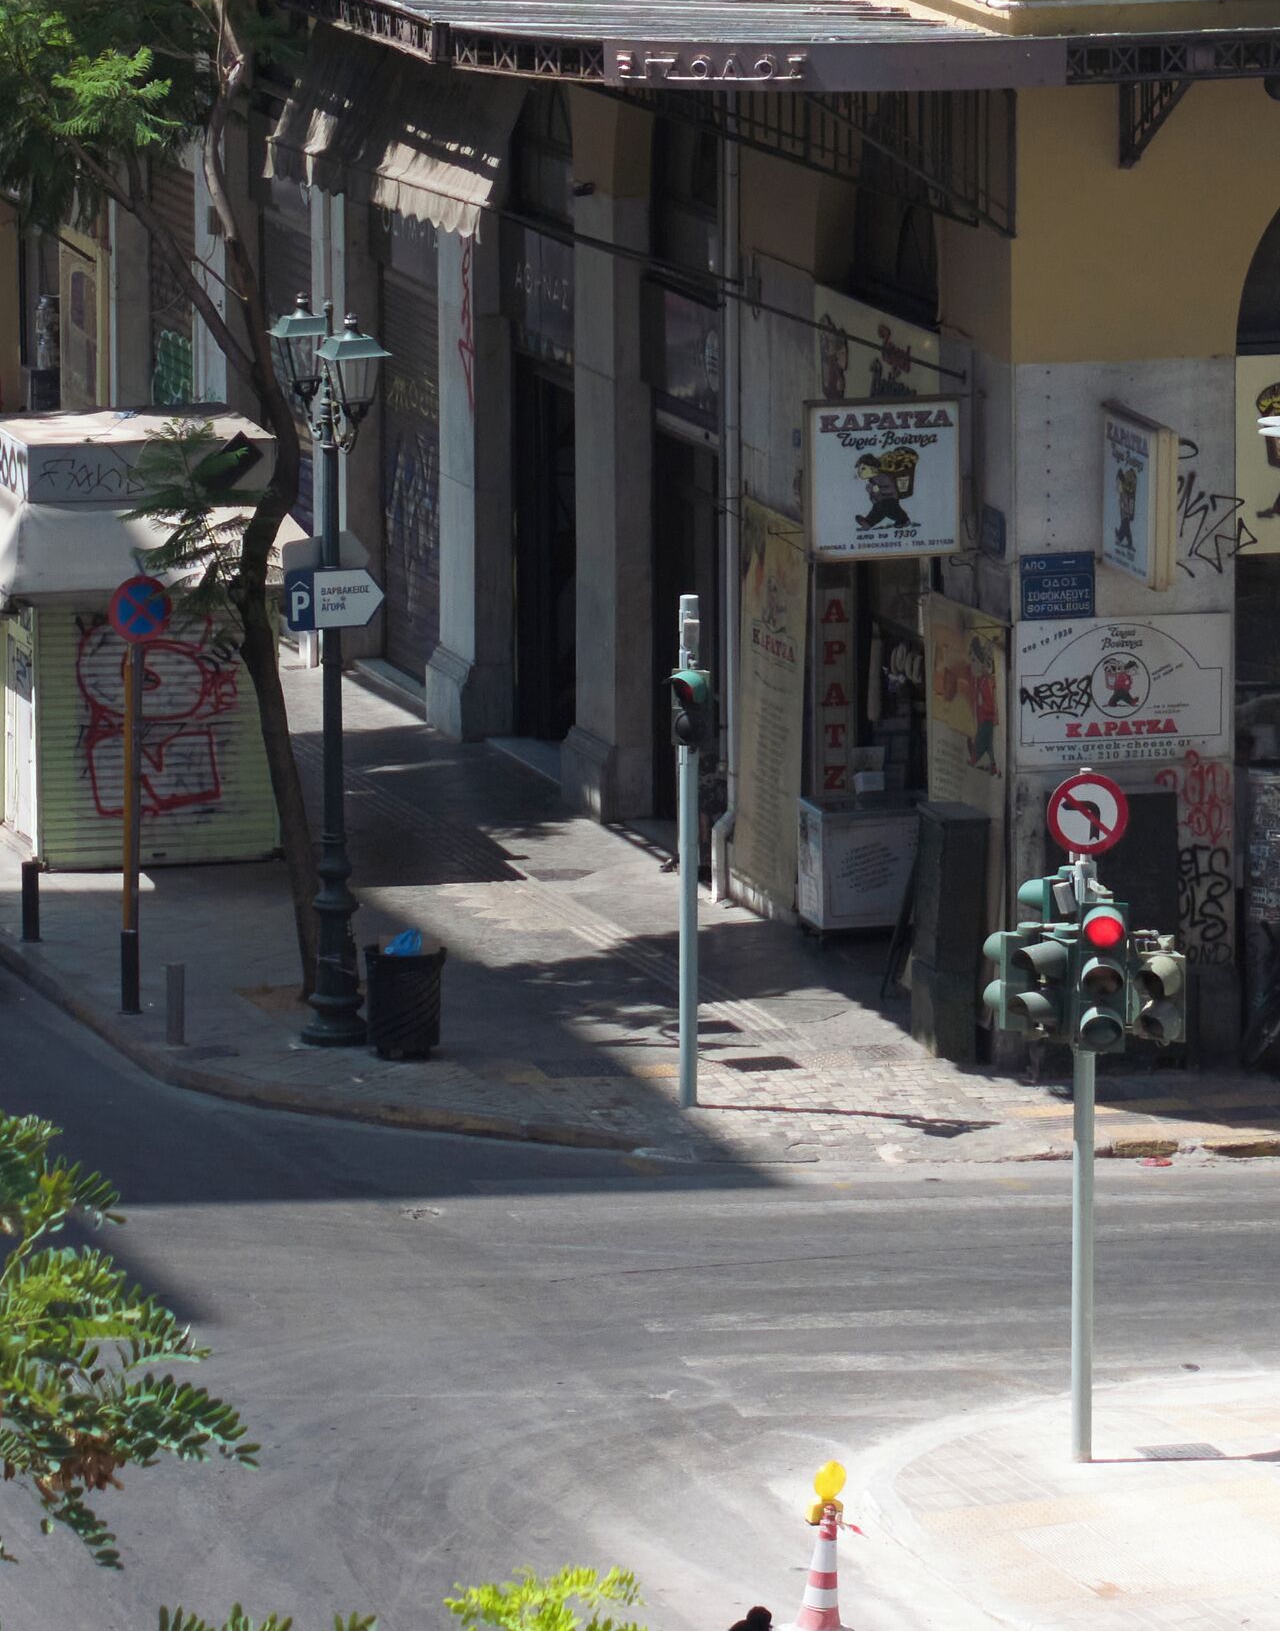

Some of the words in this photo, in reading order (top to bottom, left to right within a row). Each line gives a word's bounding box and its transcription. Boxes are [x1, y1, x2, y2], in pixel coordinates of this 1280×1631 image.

[820, 409, 953, 433] ΚΑΡΑΤΖΑ
[1042, 577, 1077, 588] ΟΔΟΣ
[1065, 718, 1178, 738] ΚΑΡΑΤΖΑ
